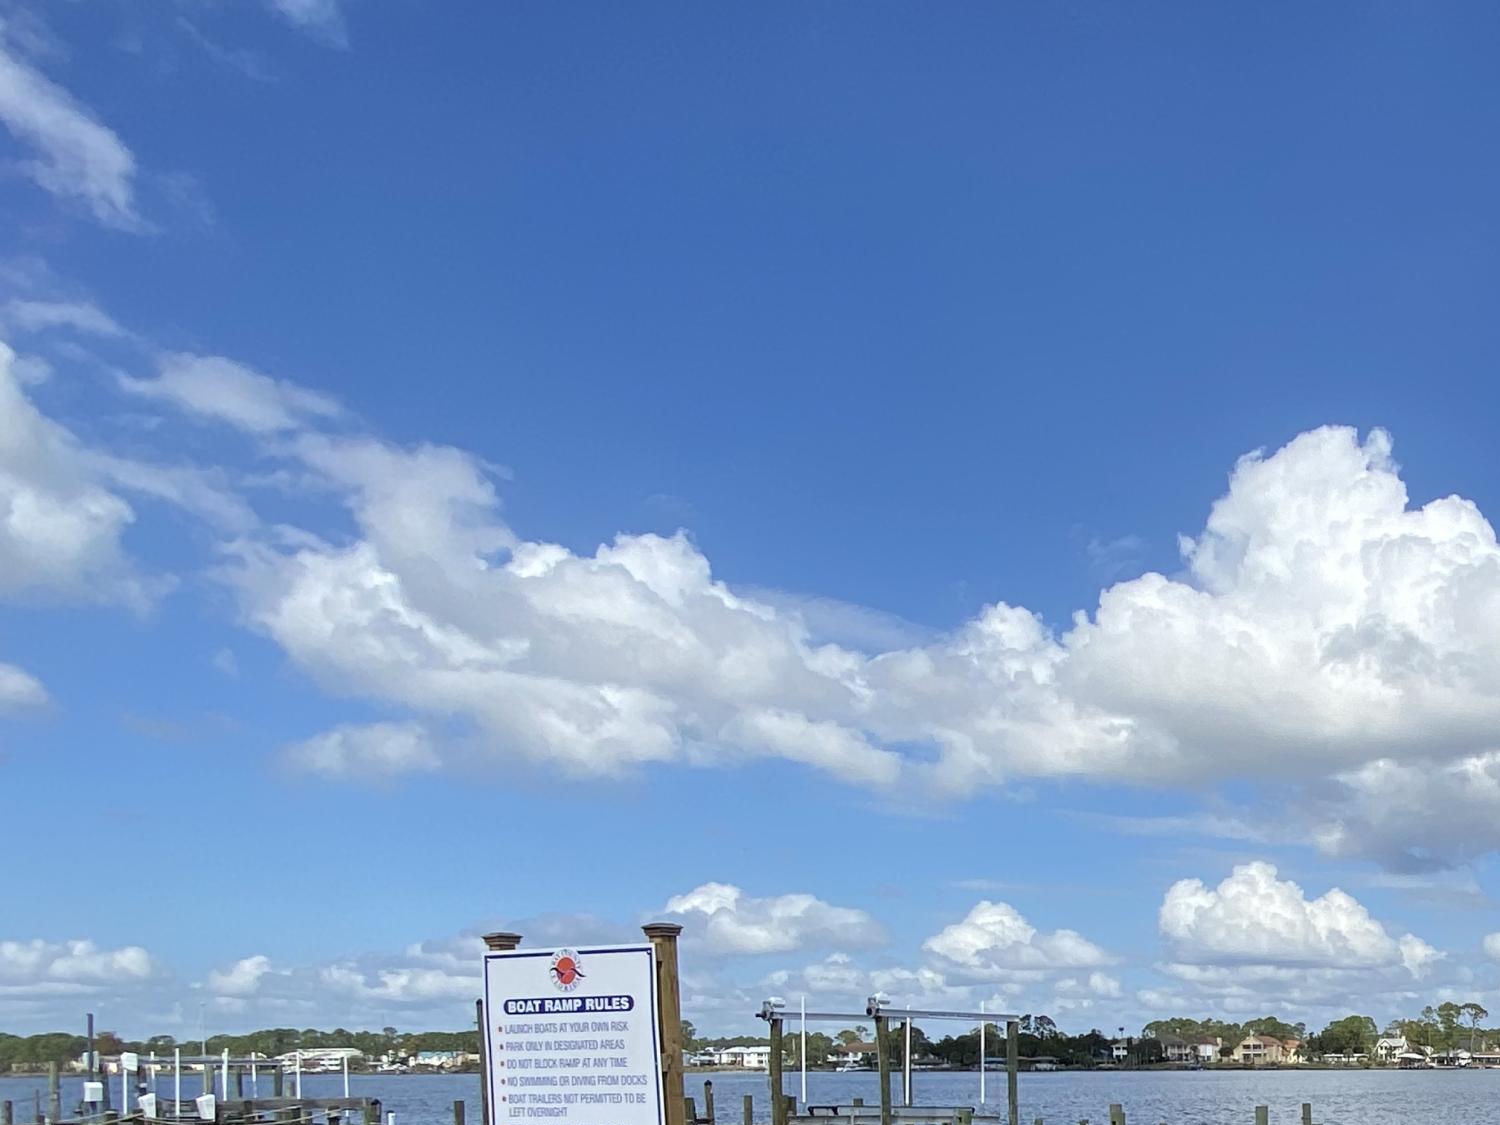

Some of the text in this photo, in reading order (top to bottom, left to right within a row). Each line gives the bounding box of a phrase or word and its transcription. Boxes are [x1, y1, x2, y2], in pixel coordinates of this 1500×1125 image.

[507, 997, 629, 1013] BOAT RAMP RULES
[504, 1022, 628, 1034] LAUNCH BOATS AT YOUR OWN RISK
[506, 1039, 624, 1051] PARK ONLY IN DESIGNATED AREAS
[507, 1057, 627, 1069] DO NOT BLOCK RAMP AT ANY TIME
[508, 1075, 647, 1086] NO SWIMMING OR DIVING FROM DOCKS
[509, 1093, 646, 1104] BOAT TRAILERS NOT PERMITTED TO BE
[509, 1107, 567, 1117] LEFT OVERNIGHT
